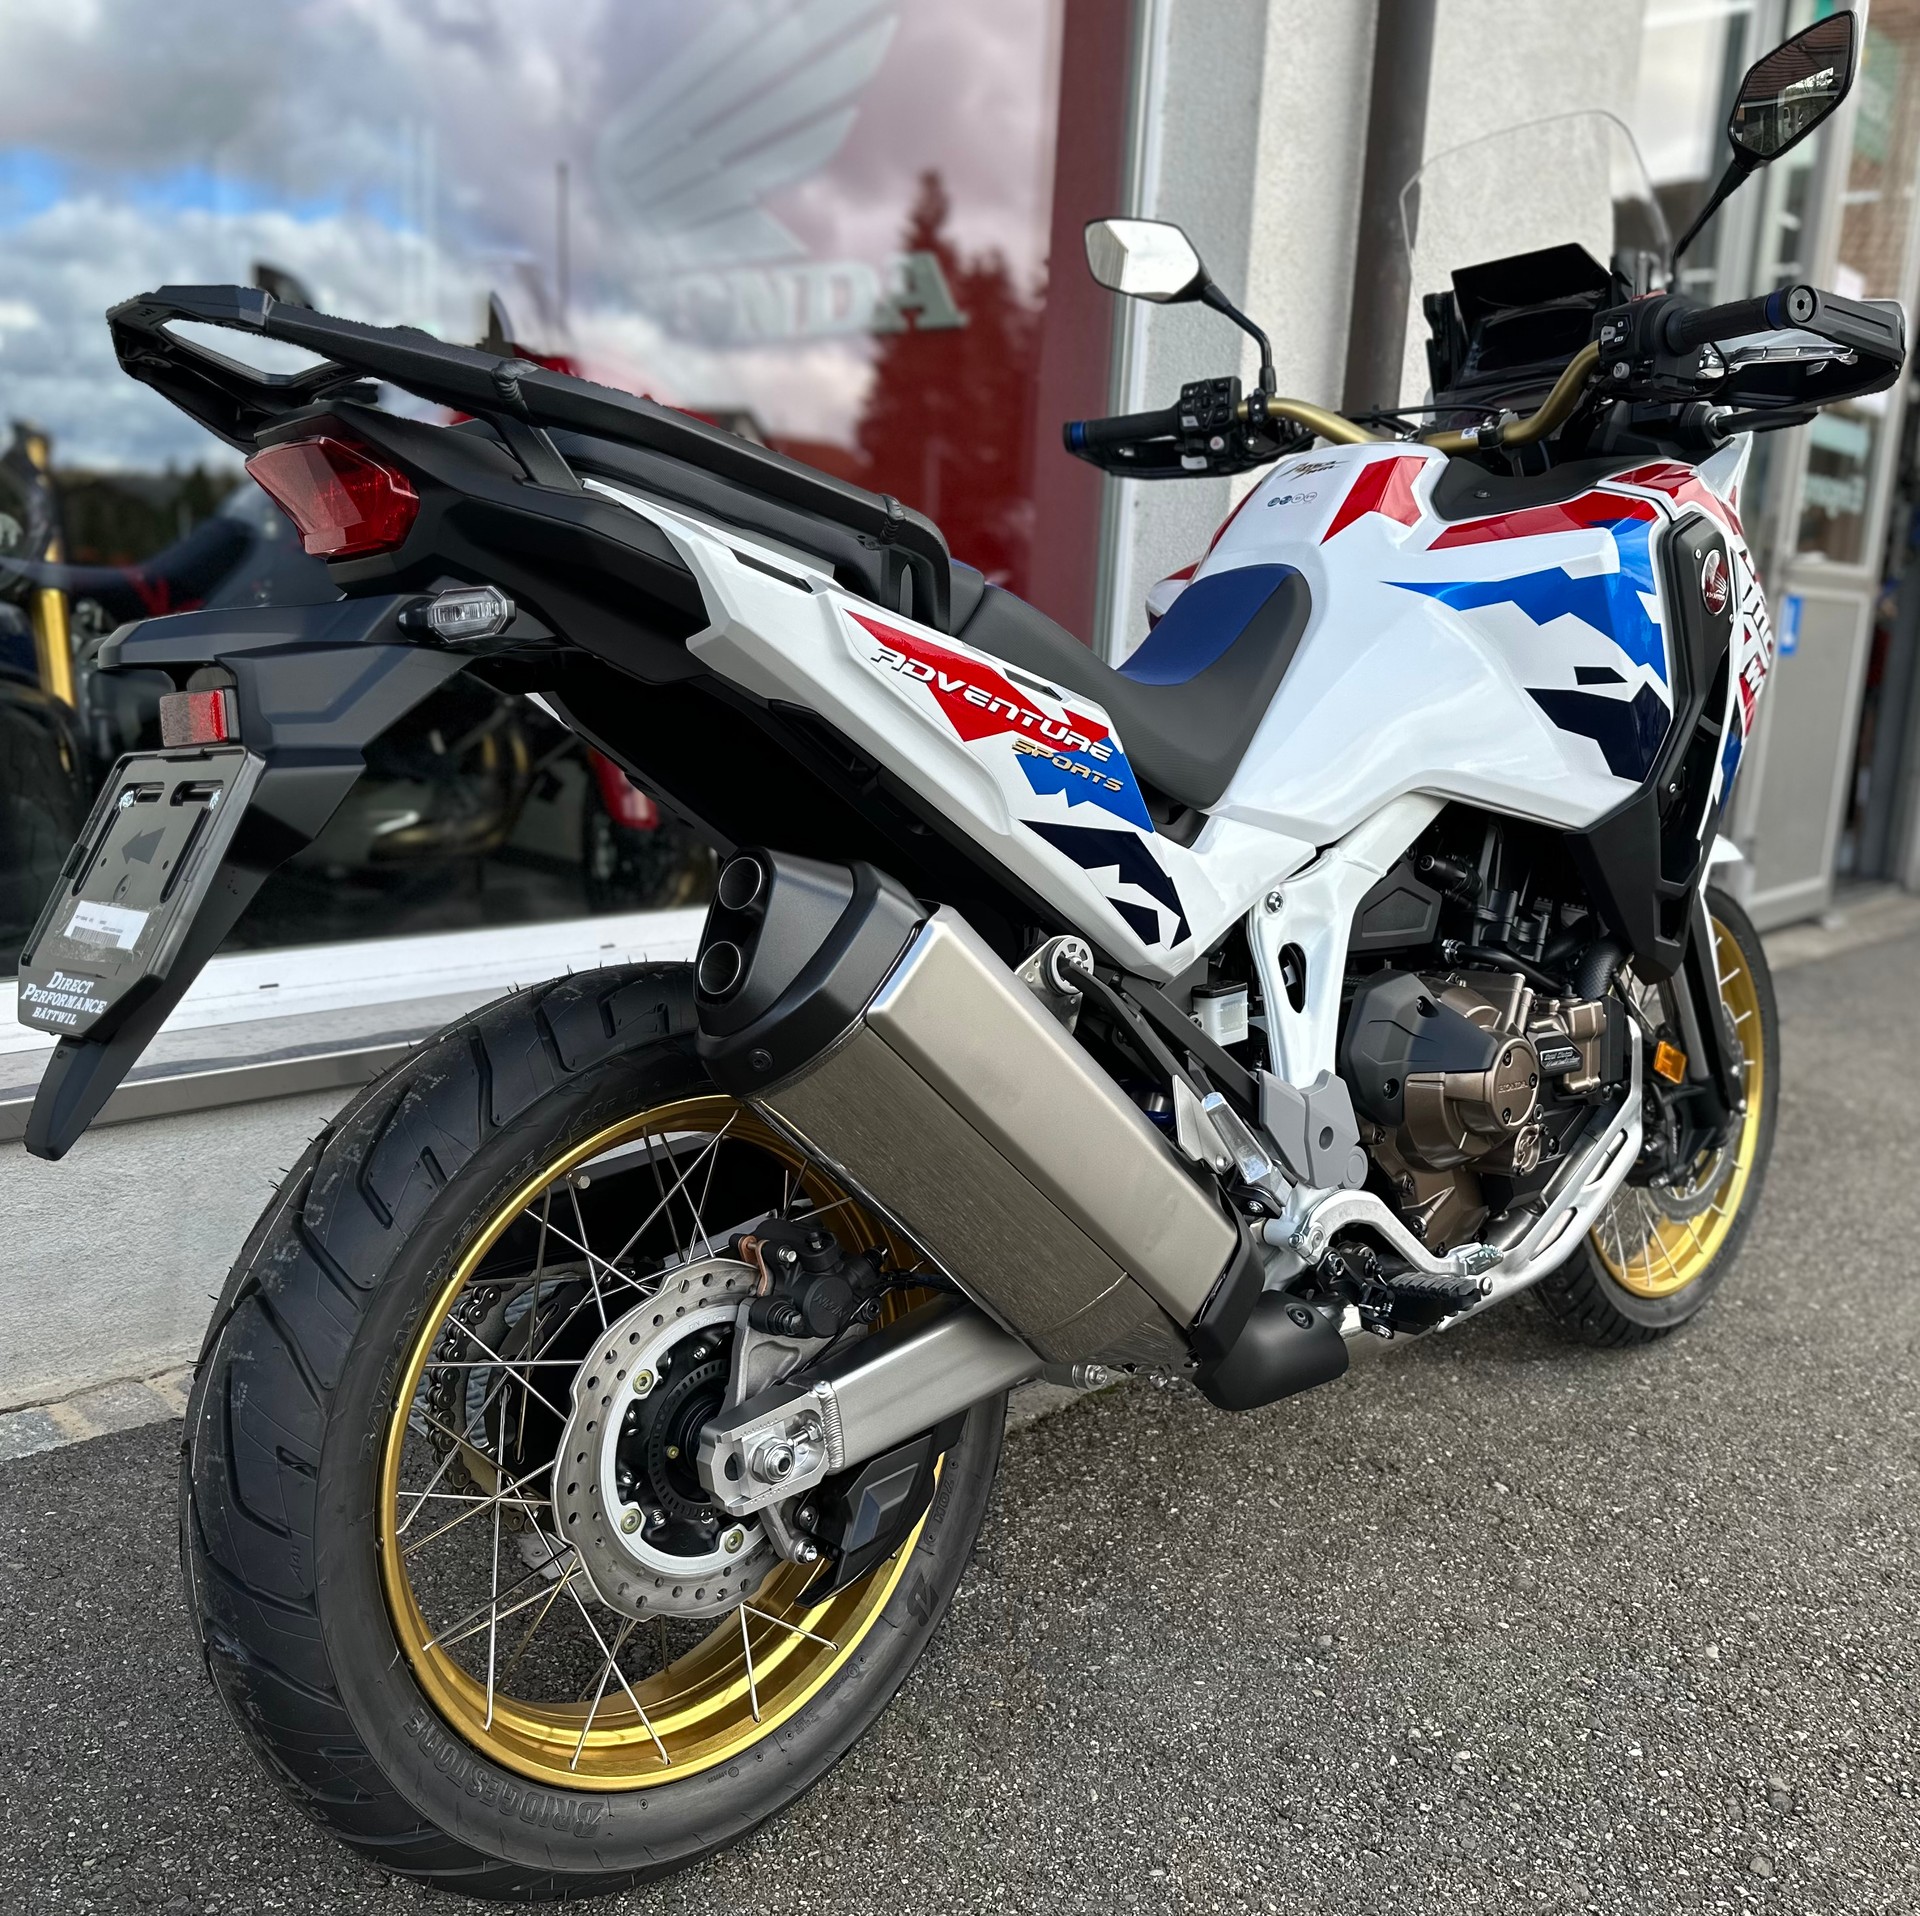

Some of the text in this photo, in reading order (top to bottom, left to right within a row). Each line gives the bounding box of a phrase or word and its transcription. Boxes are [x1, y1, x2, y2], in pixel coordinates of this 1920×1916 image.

[870, 648, 1113, 762] ADVENTURE
[1012, 737, 1124, 792] SPORTS
[20, 983, 107, 1014] PERFORMANCE
[46, 971, 94, 994] DIRECT
[403, 1706, 605, 1838] BRIDGESTONE
